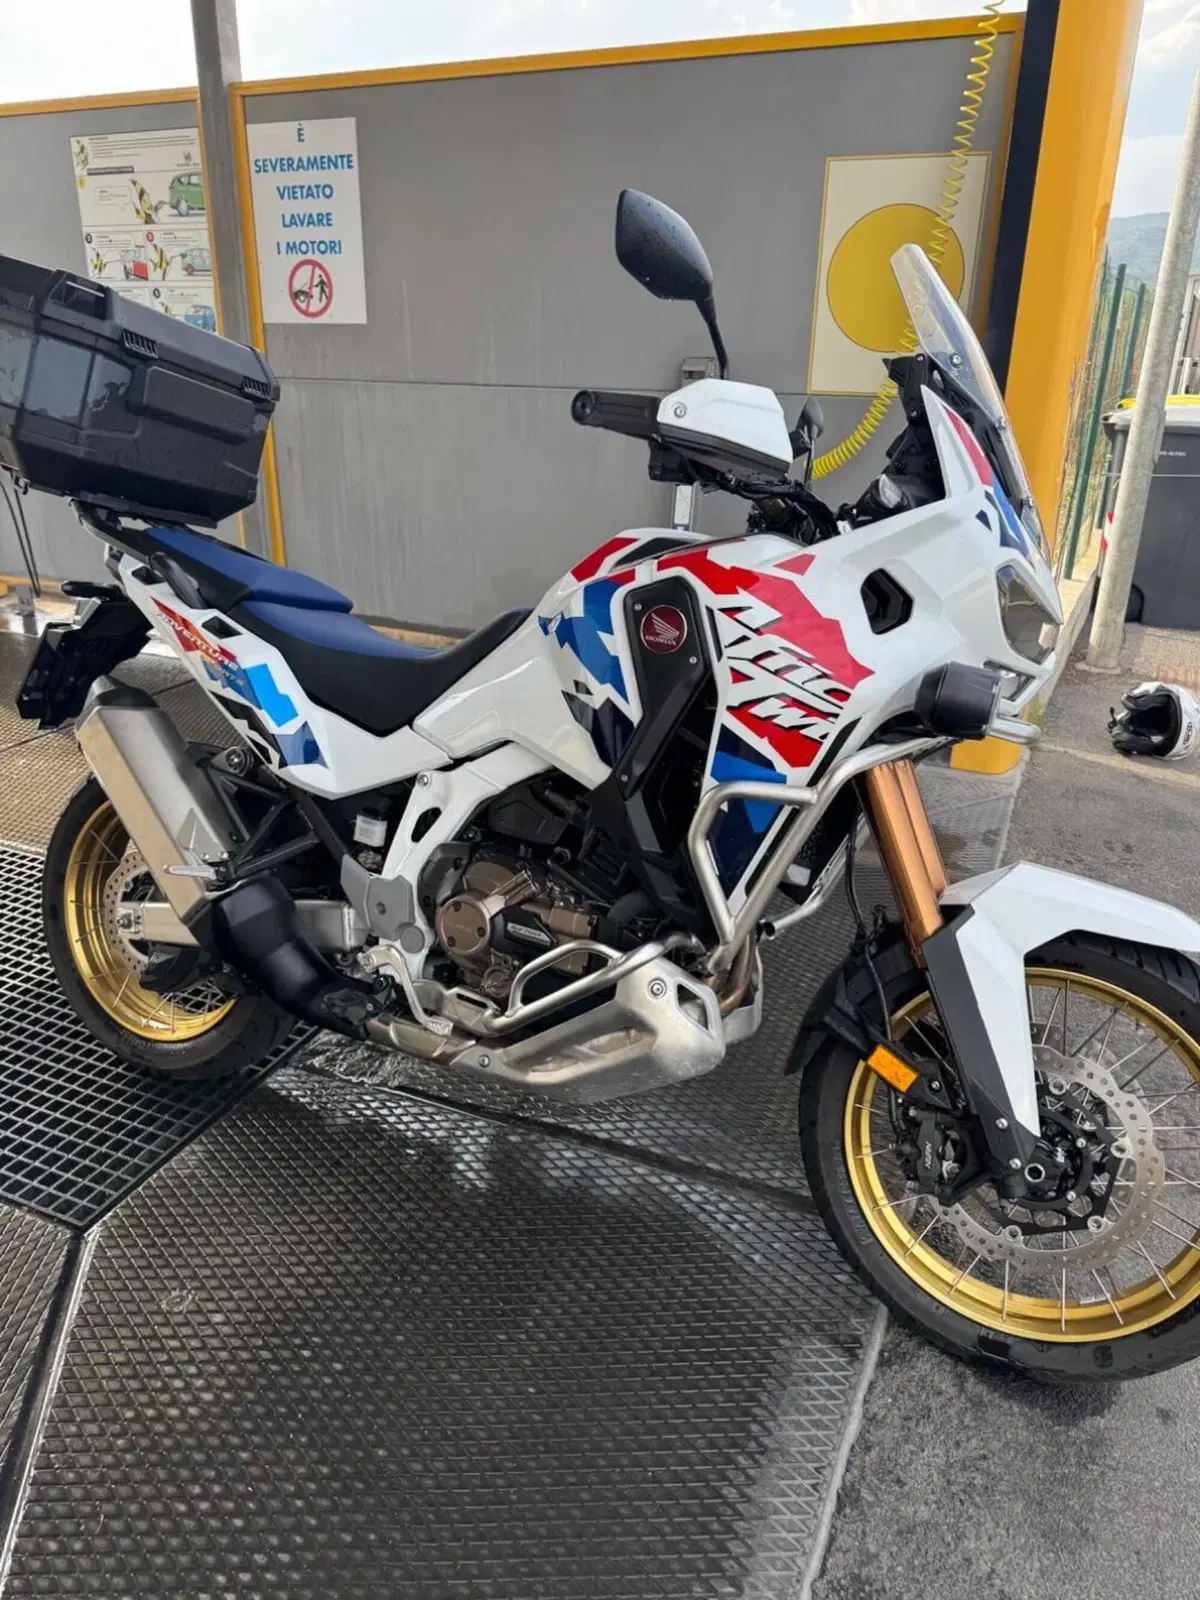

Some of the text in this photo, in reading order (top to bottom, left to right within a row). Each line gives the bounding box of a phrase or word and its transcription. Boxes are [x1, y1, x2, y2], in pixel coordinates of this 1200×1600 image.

[296, 122, 305, 142] È
[254, 153, 354, 174] SEVERAMENTE
[276, 183, 334, 200] VIETATO
[281, 212, 333, 228] LAVARE
[276, 240, 342, 256] I MOTORI
